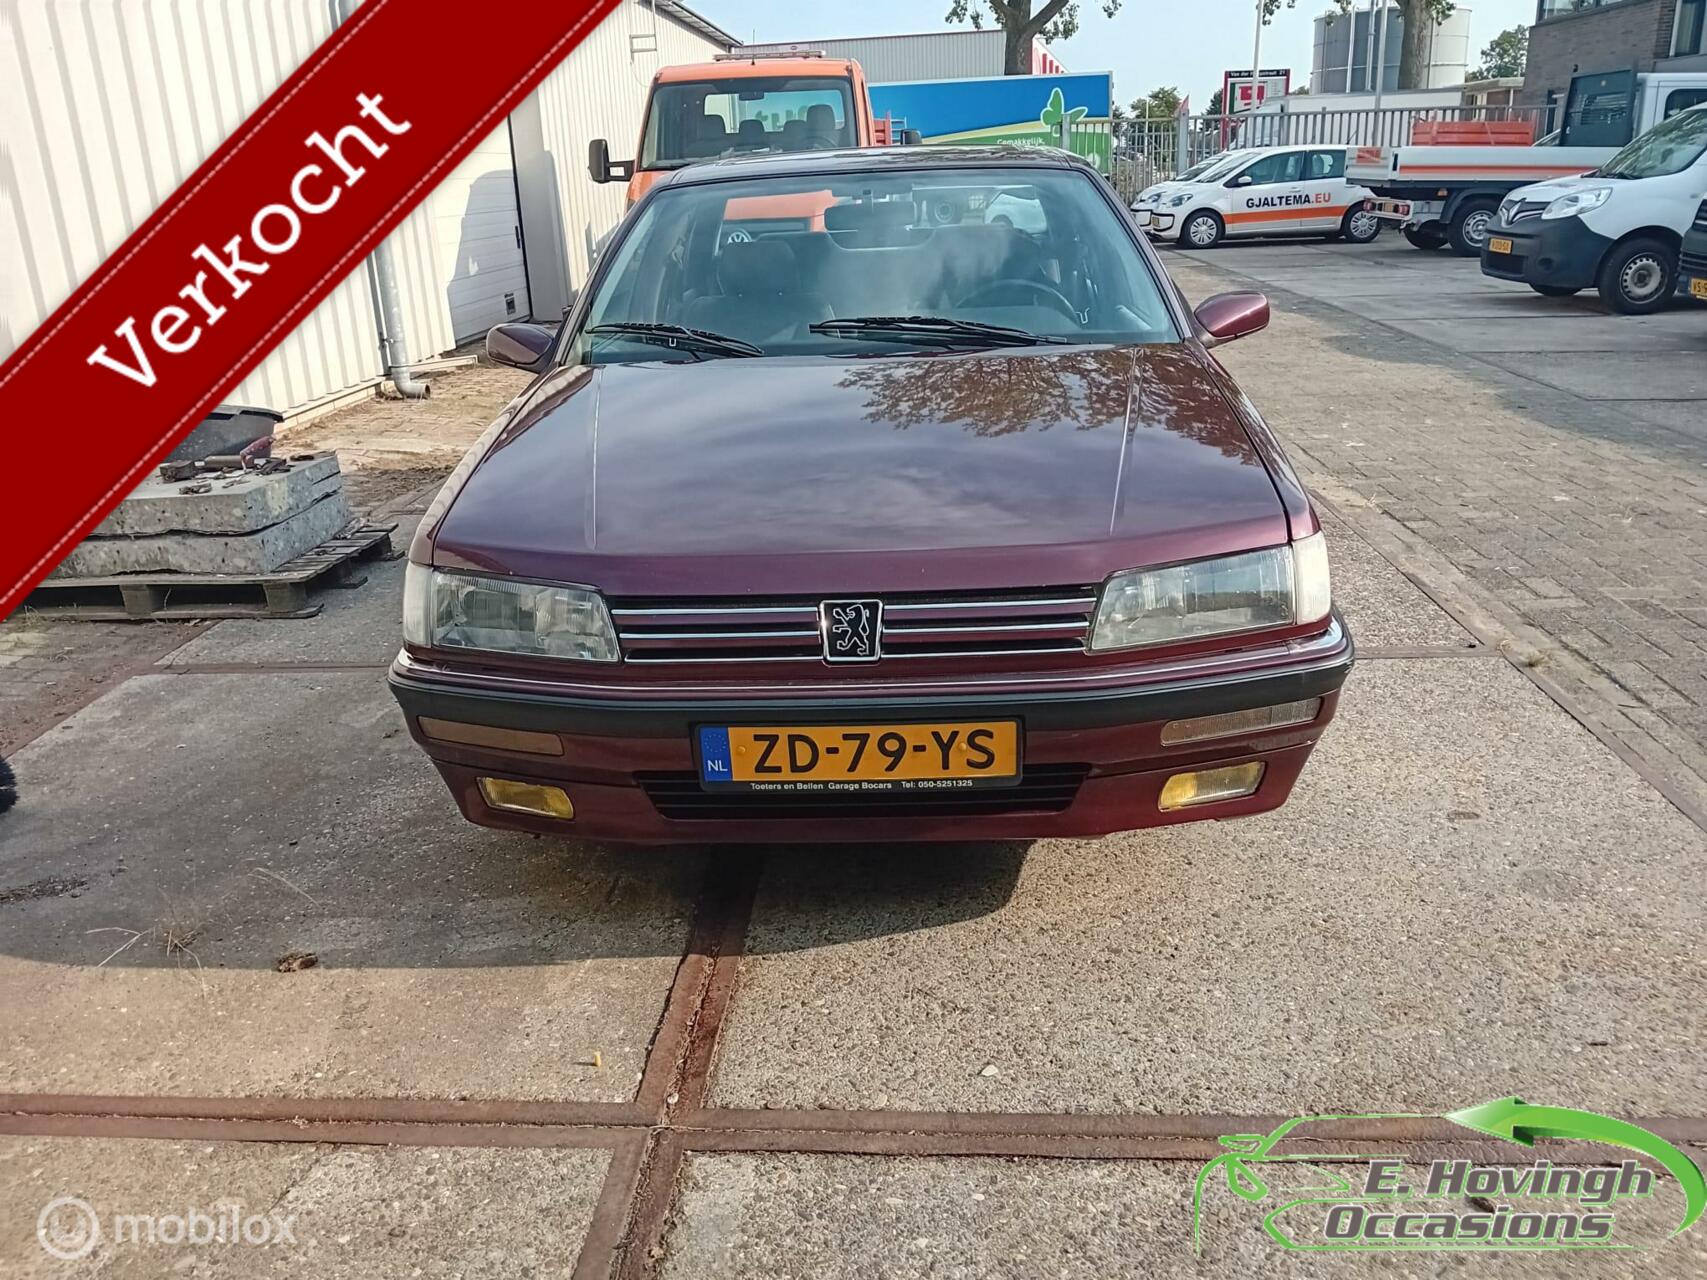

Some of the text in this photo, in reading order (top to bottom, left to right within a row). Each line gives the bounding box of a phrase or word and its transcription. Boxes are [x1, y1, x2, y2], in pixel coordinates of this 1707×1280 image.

[1246, 192, 1331, 208] GJALTEMA.EU
[752, 728, 996, 774] ZD-79-YS
[707, 759, 728, 772] NL
[750, 782, 781, 790] Toeters
[796, 782, 823, 790] Bellen
[828, 782, 859, 792] Garage
[861, 781, 892, 790] Bocars
[901, 780, 916, 789] Tel:
[918, 778, 973, 789] 050-5251325
